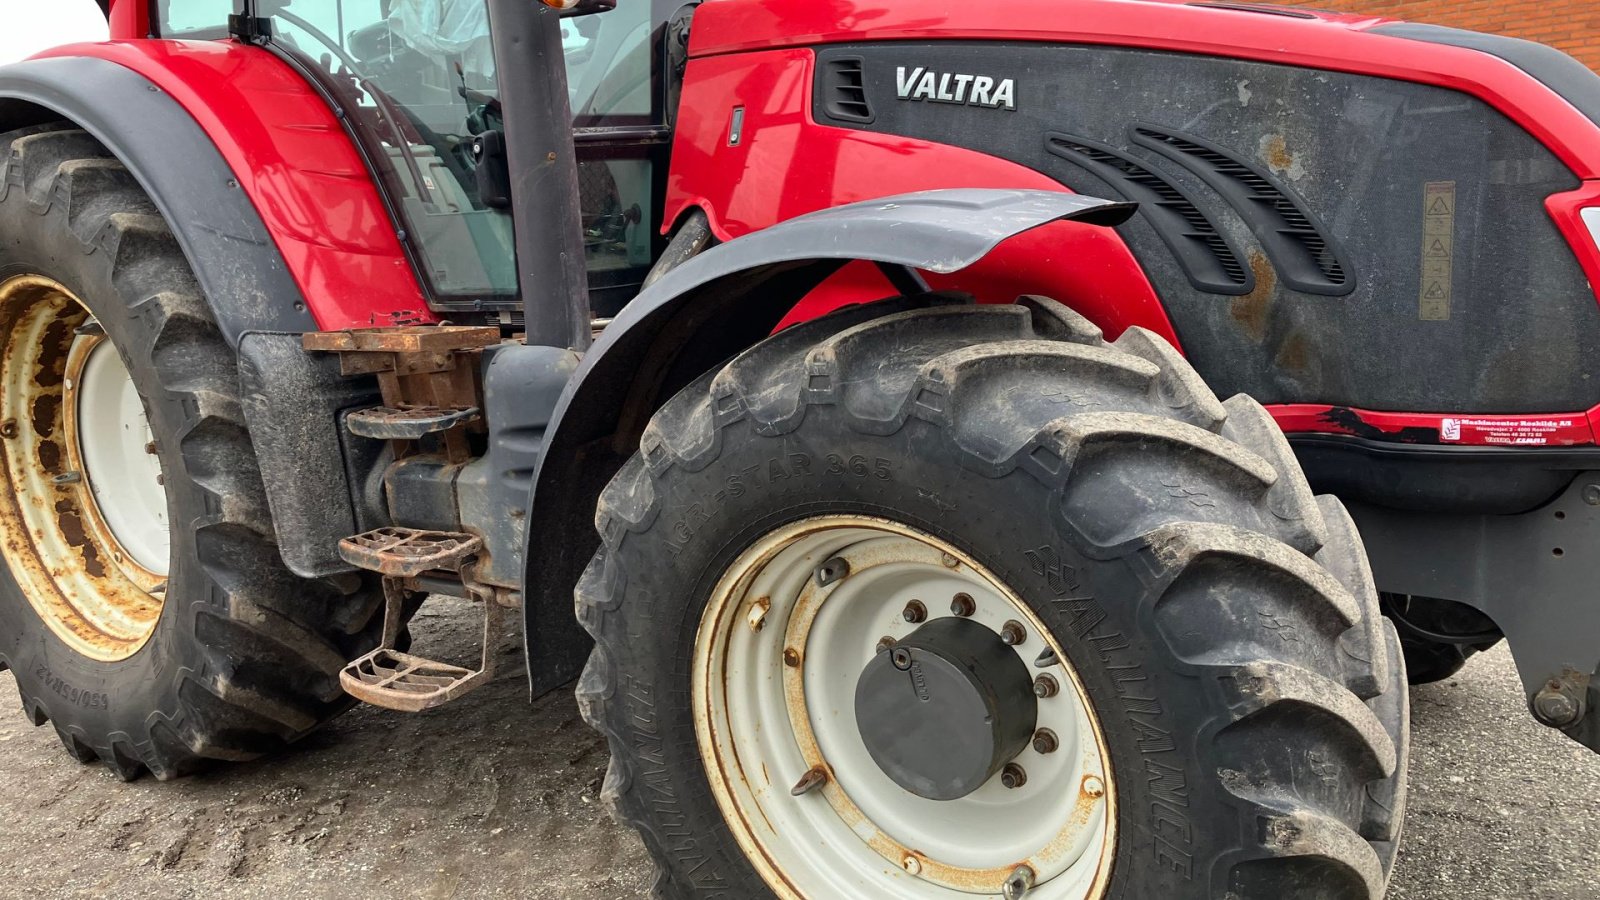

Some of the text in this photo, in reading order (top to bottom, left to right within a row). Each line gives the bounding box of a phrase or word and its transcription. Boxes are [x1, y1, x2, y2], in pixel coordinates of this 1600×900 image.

[896, 66, 1014, 107] VALTRA
[824, 453, 892, 481] 365
[624, 673, 730, 889] ALLIANCE
[1051, 597, 1193, 881] ALLIANCE
